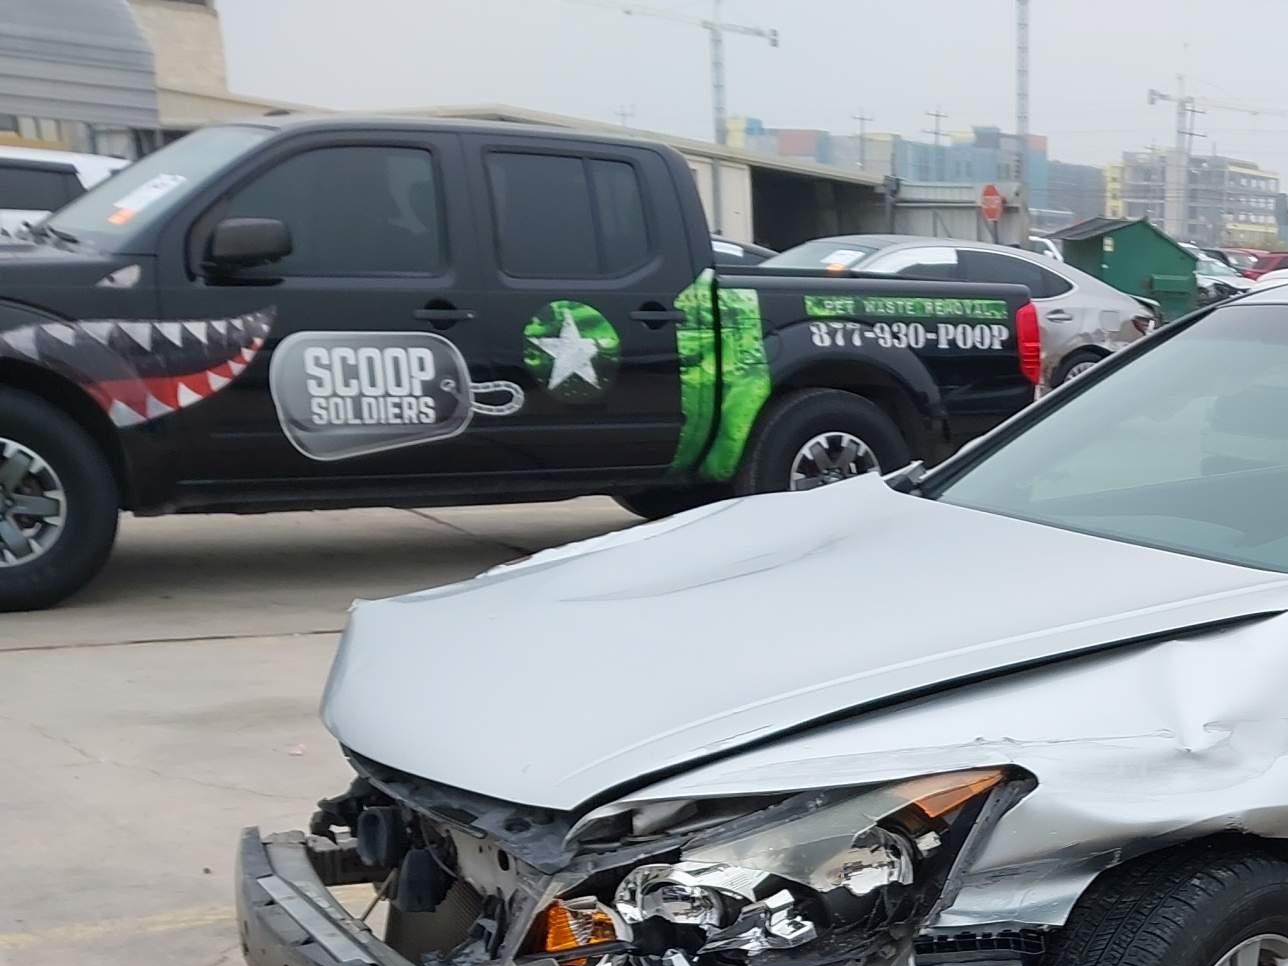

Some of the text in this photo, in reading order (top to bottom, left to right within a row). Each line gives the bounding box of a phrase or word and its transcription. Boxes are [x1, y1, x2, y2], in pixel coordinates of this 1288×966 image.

[808, 322, 1009, 349] 877-930-POOP
[304, 346, 436, 397] SCOOP
[310, 397, 436, 425] SOLDIERS
